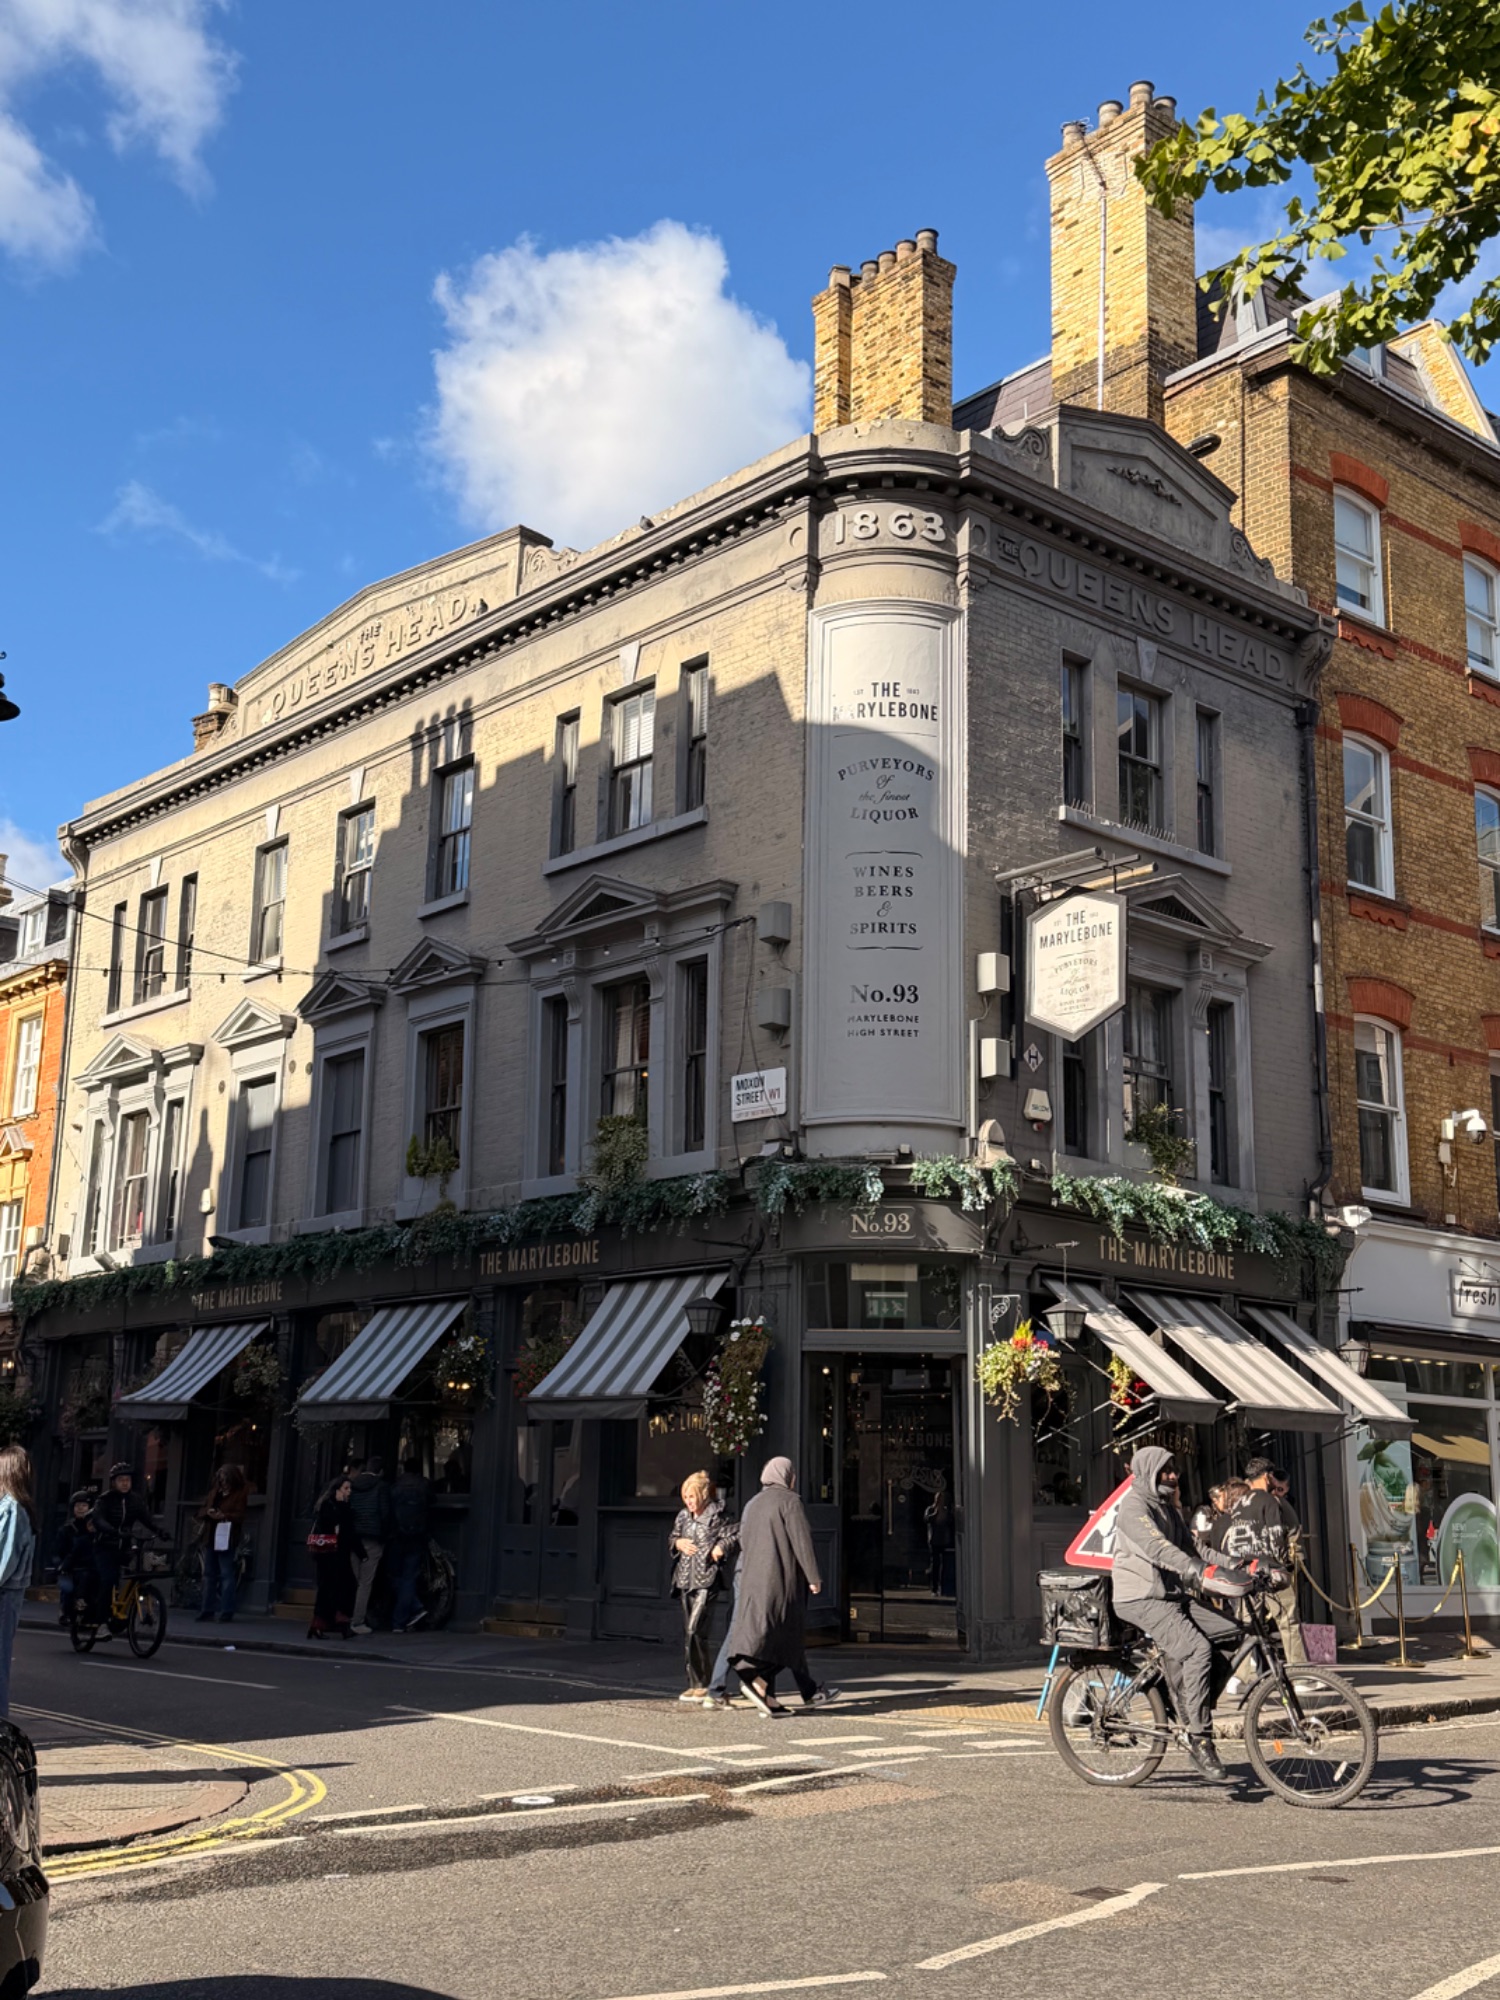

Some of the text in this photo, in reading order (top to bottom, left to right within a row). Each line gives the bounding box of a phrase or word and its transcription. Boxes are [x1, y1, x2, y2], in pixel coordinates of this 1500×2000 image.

[835, 509, 946, 544] 1863
[1018, 537, 1176, 636] QUEENS
[270, 643, 376, 721] QUEENS
[871, 682, 901, 698] THE
[833, 702, 938, 722] RYLEBONE
[837, 757, 935, 782] PURVEYORS
[874, 789, 912, 805] finest
[850, 807, 920, 825] LIQUOR
[853, 865, 914, 878] WINES
[854, 885, 914, 898] BEERS
[876, 900, 893, 918] &
[1066, 910, 1086, 927] THE
[850, 922, 917, 935] SPIRITS
[1039, 921, 1113, 950] MARYLEBONE
[850, 983, 920, 1004] No.93
[847, 1014, 920, 1024] MARYLEBONE
[847, 1028, 920, 1038] HIGH STREET
[736, 1076, 766, 1092] MOXON
[735, 1087, 781, 1106] STREET W1
[850, 1212, 911, 1233] No.93
[479, 1239, 600, 1276] THE MARYLEBONE
[1098, 1234, 1236, 1280] THE MARYLEBONE
[197, 1280, 284, 1312] THE MARYLEBONE
[1458, 1280, 1497, 1308] fresh
